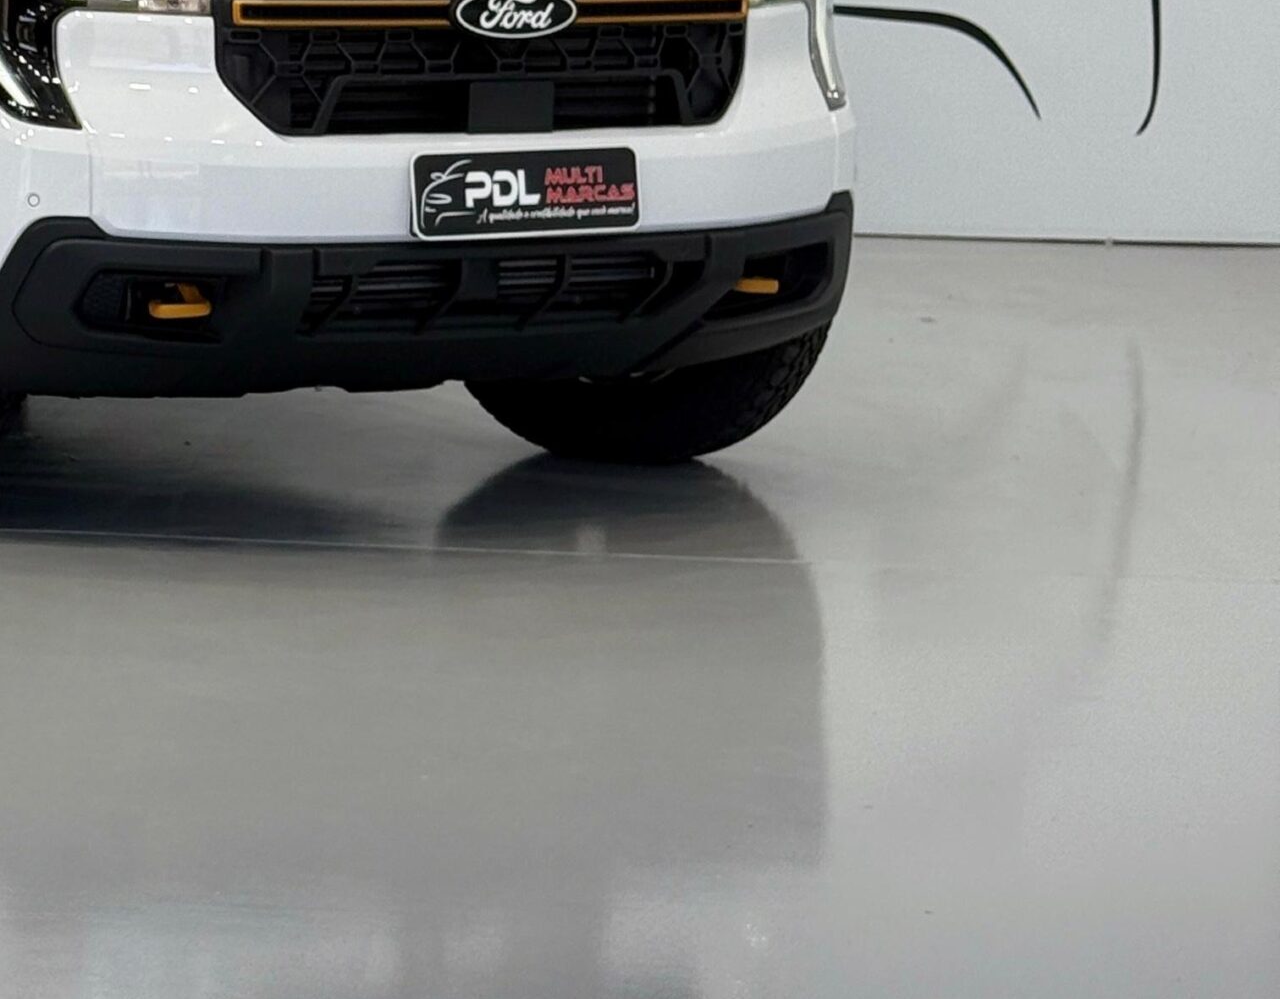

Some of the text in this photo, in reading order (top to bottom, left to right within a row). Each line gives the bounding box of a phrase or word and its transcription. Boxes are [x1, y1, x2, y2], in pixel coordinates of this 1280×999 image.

[545, 165, 603, 186] MULTI
[465, 168, 541, 208] PDL
[545, 183, 636, 205] MARCAS
